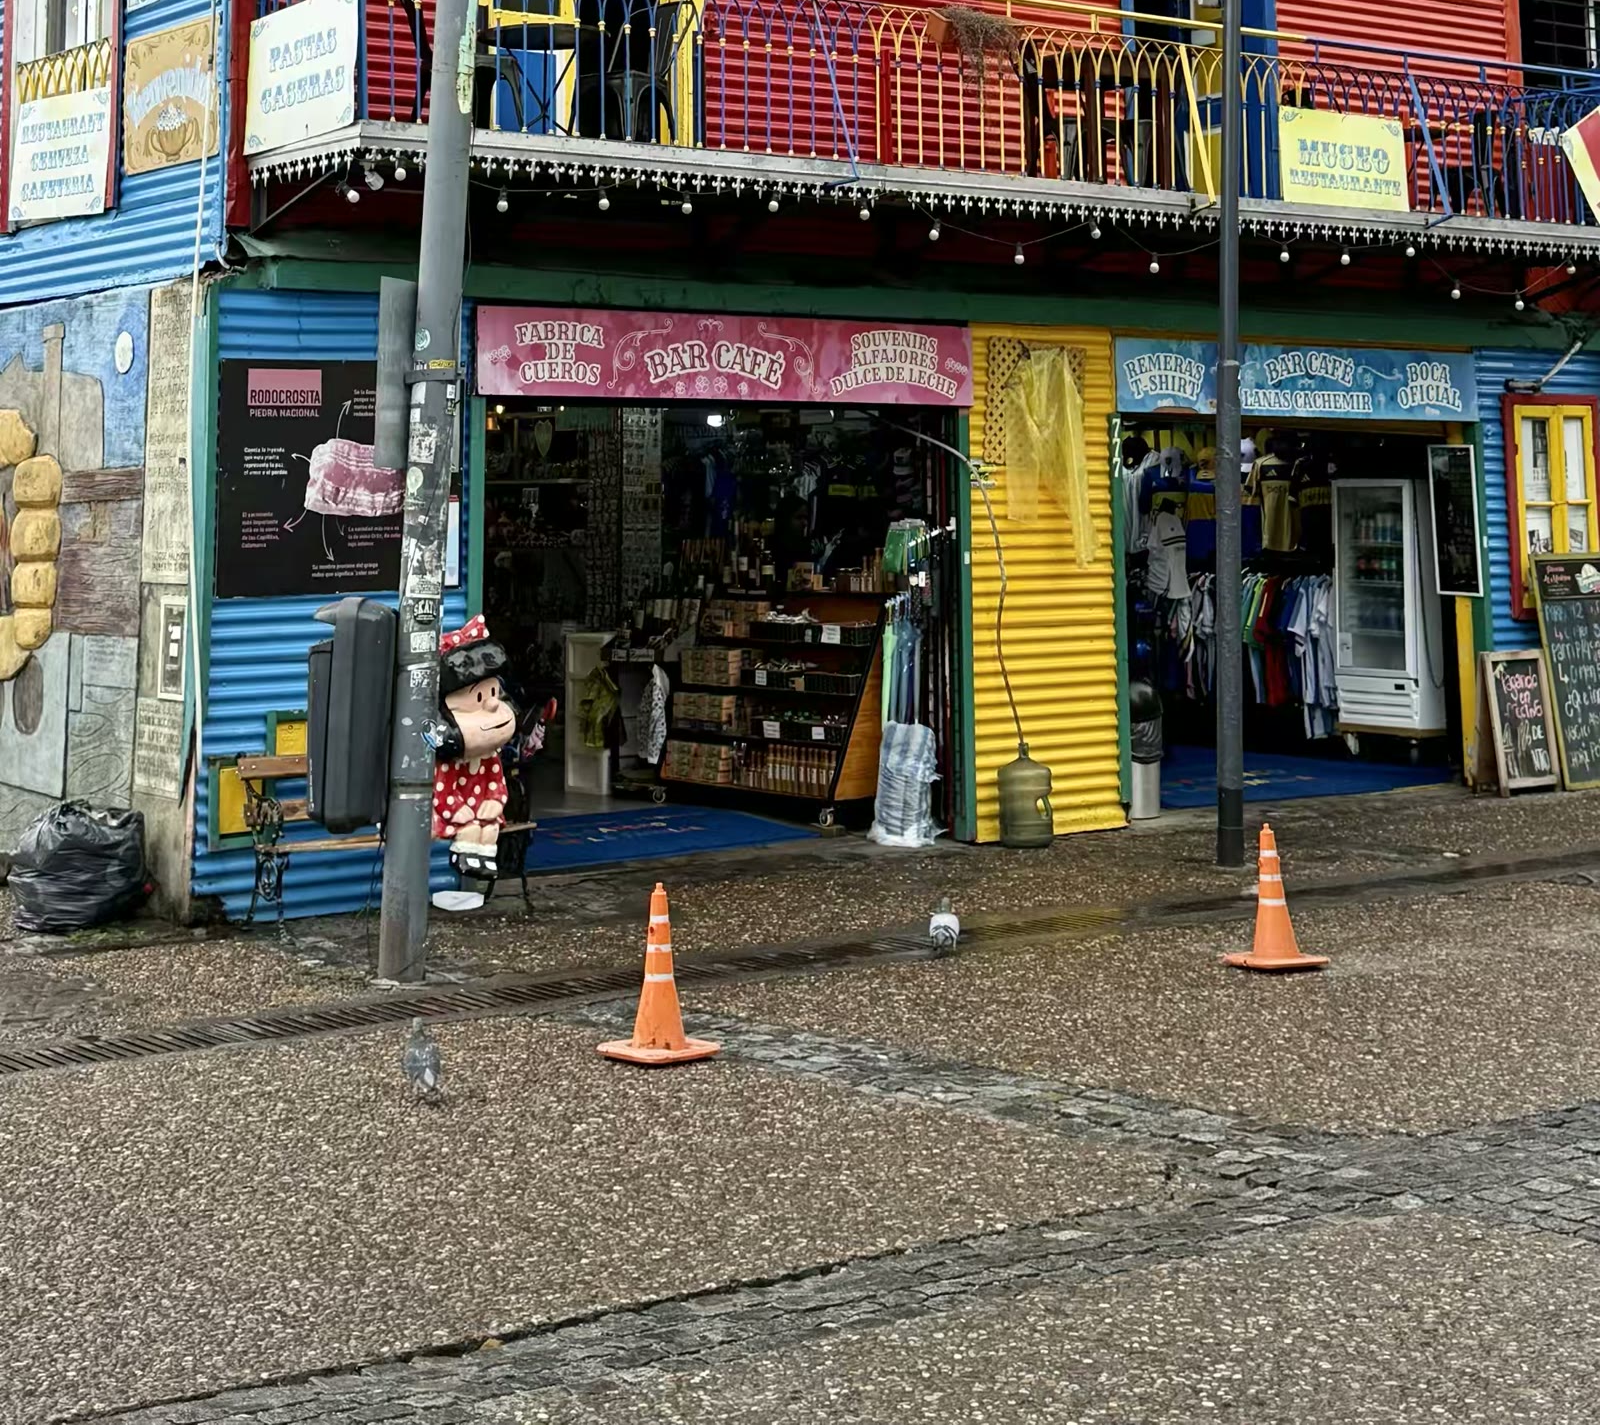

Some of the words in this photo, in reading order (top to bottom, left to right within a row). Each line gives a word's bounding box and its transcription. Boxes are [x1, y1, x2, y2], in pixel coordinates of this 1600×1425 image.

[269, 27, 337, 73] PASTAS
[260, 65, 345, 114] CASERAS
[20, 111, 106, 145] RESTAURANT
[31, 144, 89, 172] CERVEZA
[1297, 138, 1390, 175] MUSEO
[21, 173, 95, 203] CAFETERIA
[1289, 167, 1402, 197] RESTAURANTE
[515, 321, 604, 348] FABRICA
[851, 330, 937, 354] SOUVENIRS
[546, 341, 575, 362] DE
[646, 341, 708, 382] BAR
[713, 341, 784, 388] CAFÉ
[852, 348, 937, 371] ALFAJORES
[520, 361, 601, 385] CUEROS
[1124, 354, 1204, 382] REMERAS
[1265, 352, 1304, 383] BAR
[1307, 352, 1354, 386] CAFÉ
[1407, 362, 1449, 384] BOCA
[831, 367, 881, 395] DULCE
[885, 366, 905, 382] DE
[909, 368, 956, 398] LECHE
[1130, 374, 1200, 399] T-SHIRT
[250, 389, 320, 404] RODOCROSITA
[1241, 389, 1292, 409] LANAS
[1294, 391, 1372, 411] CACHEMIR
[1399, 384, 1461, 410] OFICIAL
[249, 408, 278, 418] PIEDRA
[280, 408, 320, 418] NACIONAL
